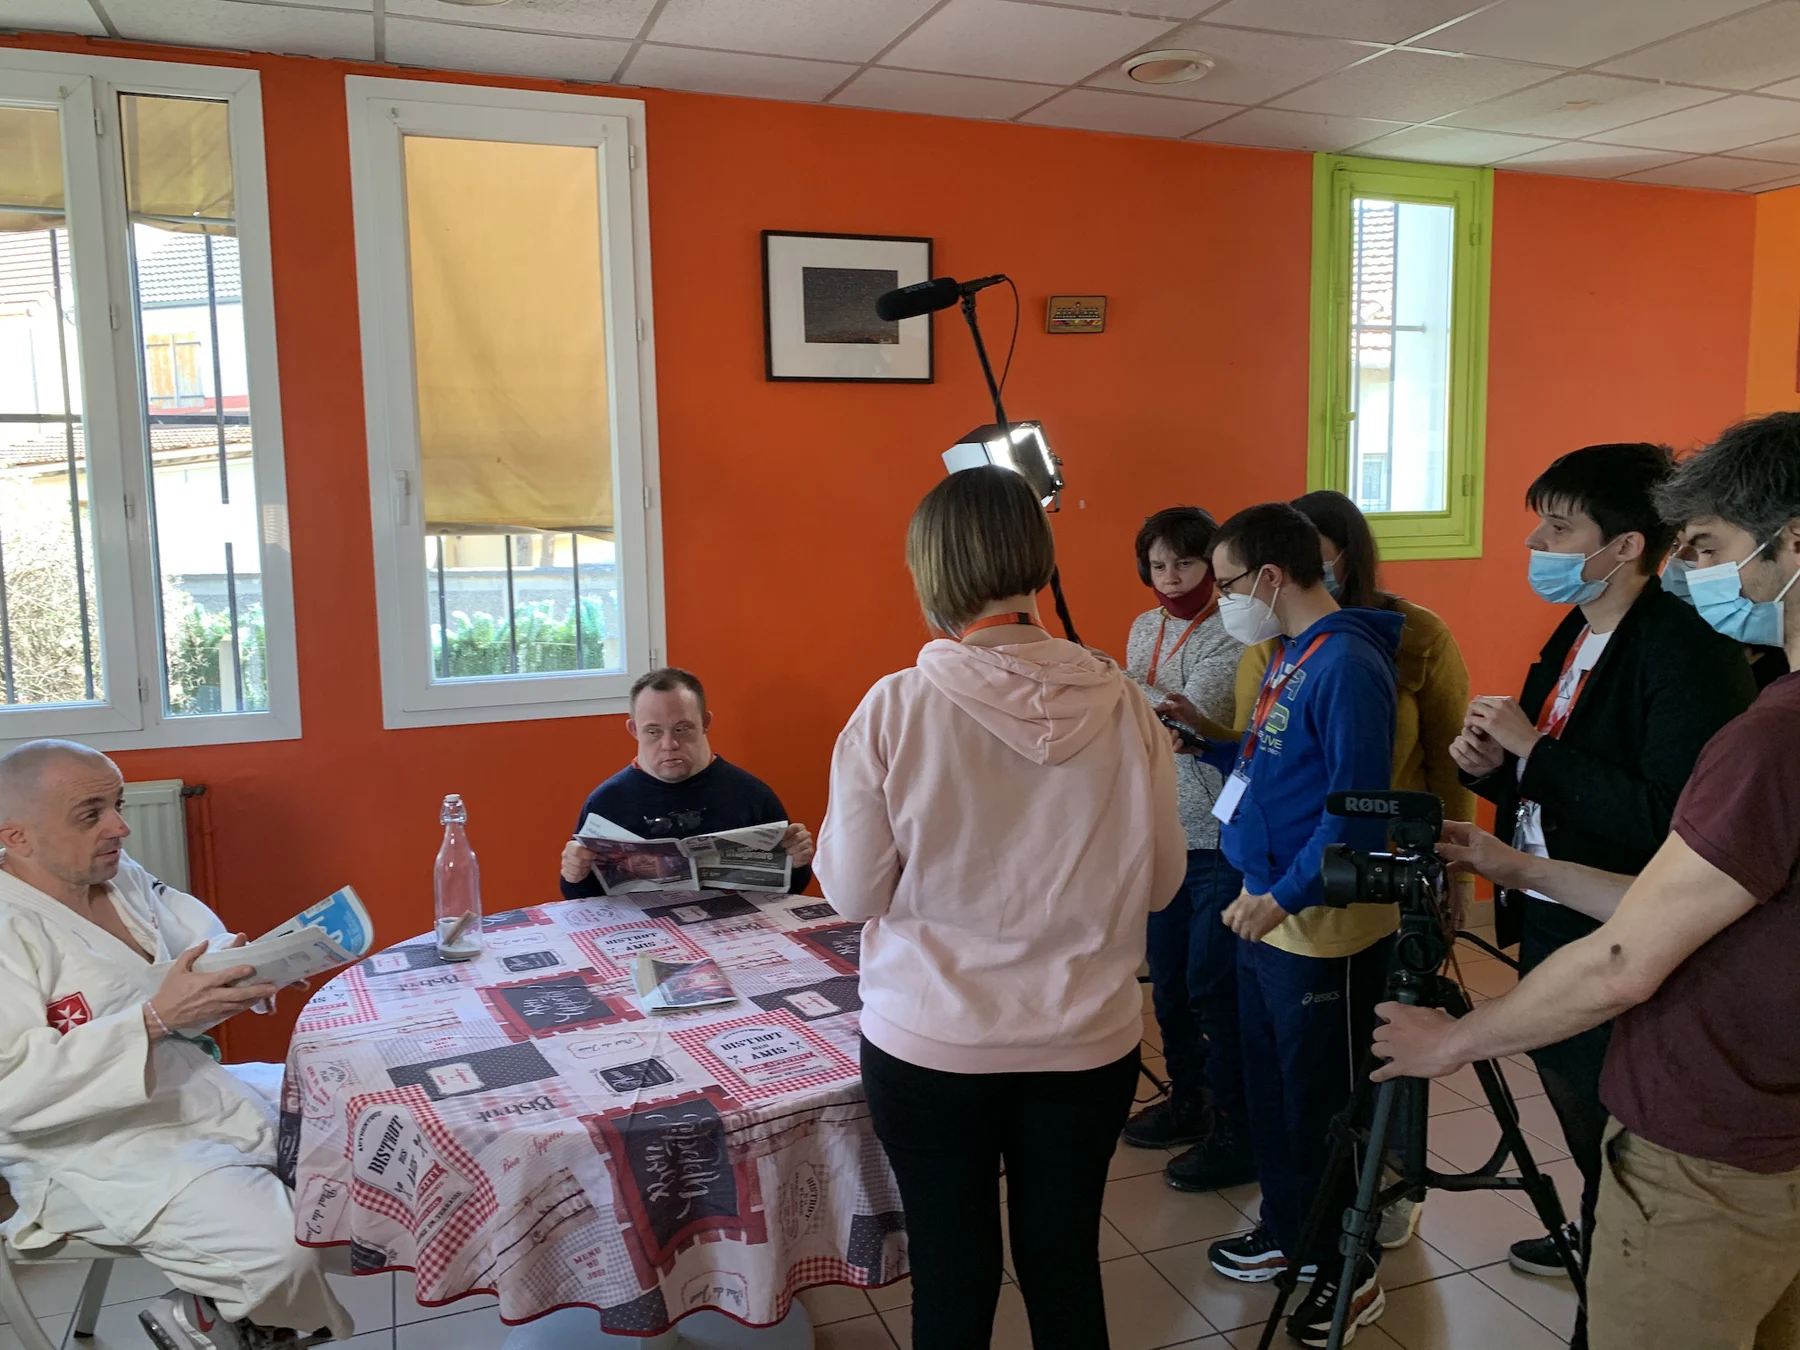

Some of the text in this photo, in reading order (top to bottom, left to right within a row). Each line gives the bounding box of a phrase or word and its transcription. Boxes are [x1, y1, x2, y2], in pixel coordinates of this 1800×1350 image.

[1345, 797, 1400, 815] RØDE
[720, 1031, 784, 1051] BISTROT
[751, 1046, 788, 1060] AMIS
[367, 1114, 404, 1175] BISTROT
[572, 1246, 601, 1263] MENU
[586, 1258, 599, 1268] DU
